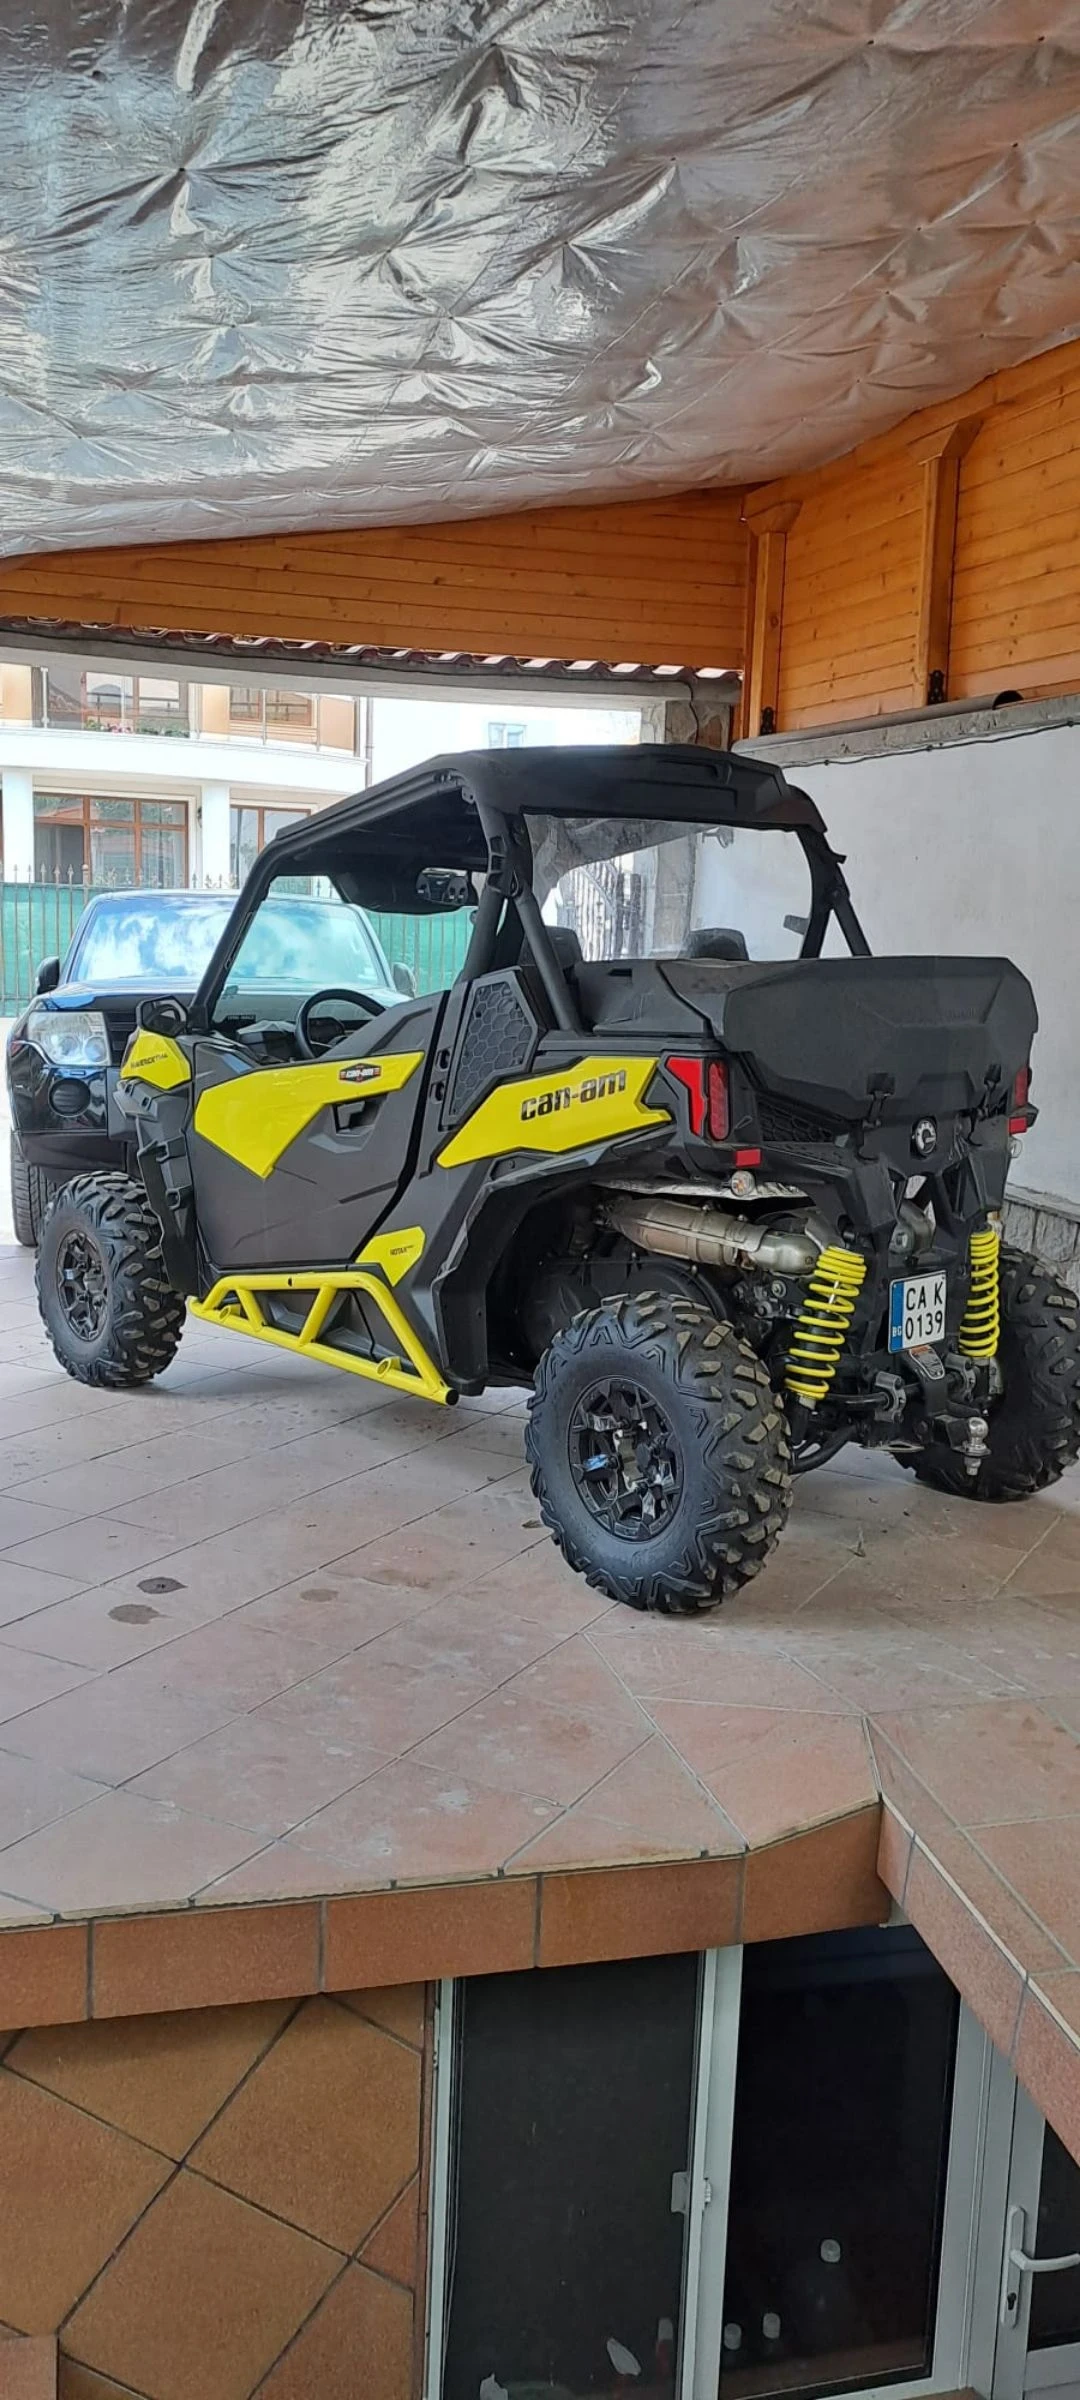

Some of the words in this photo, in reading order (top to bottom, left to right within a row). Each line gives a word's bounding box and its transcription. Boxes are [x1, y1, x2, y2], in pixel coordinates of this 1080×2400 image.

[521, 1069, 626, 1121] can-am
[906, 1286, 927, 1311] CA
[934, 1281, 944, 1307] K
[905, 1310, 943, 1340] 0139
